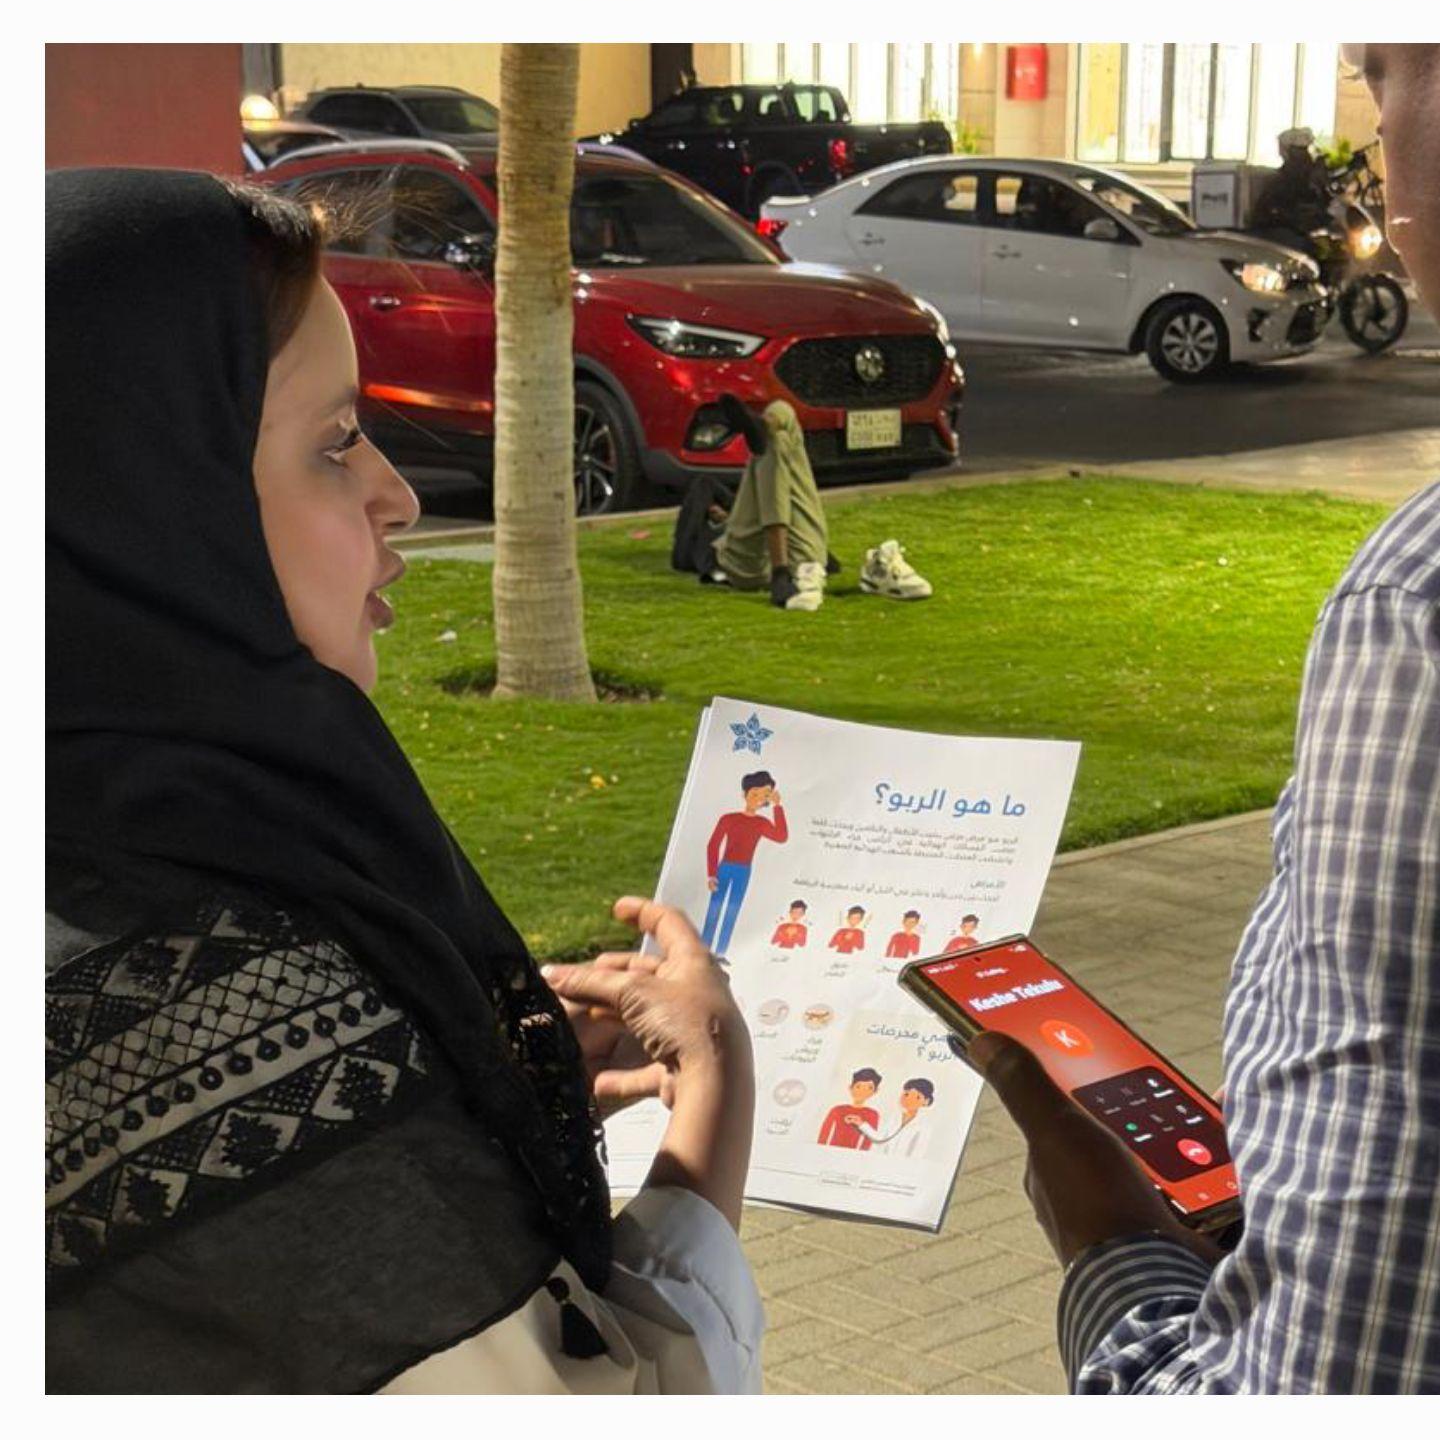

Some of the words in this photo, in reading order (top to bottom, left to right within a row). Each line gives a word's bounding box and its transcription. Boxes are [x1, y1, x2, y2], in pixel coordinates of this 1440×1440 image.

[875, 782, 946, 813] الربو؟
[953, 795, 991, 818] هو
[1003, 794, 1026, 816] ما
[1054, 1029, 1079, 1048] K
